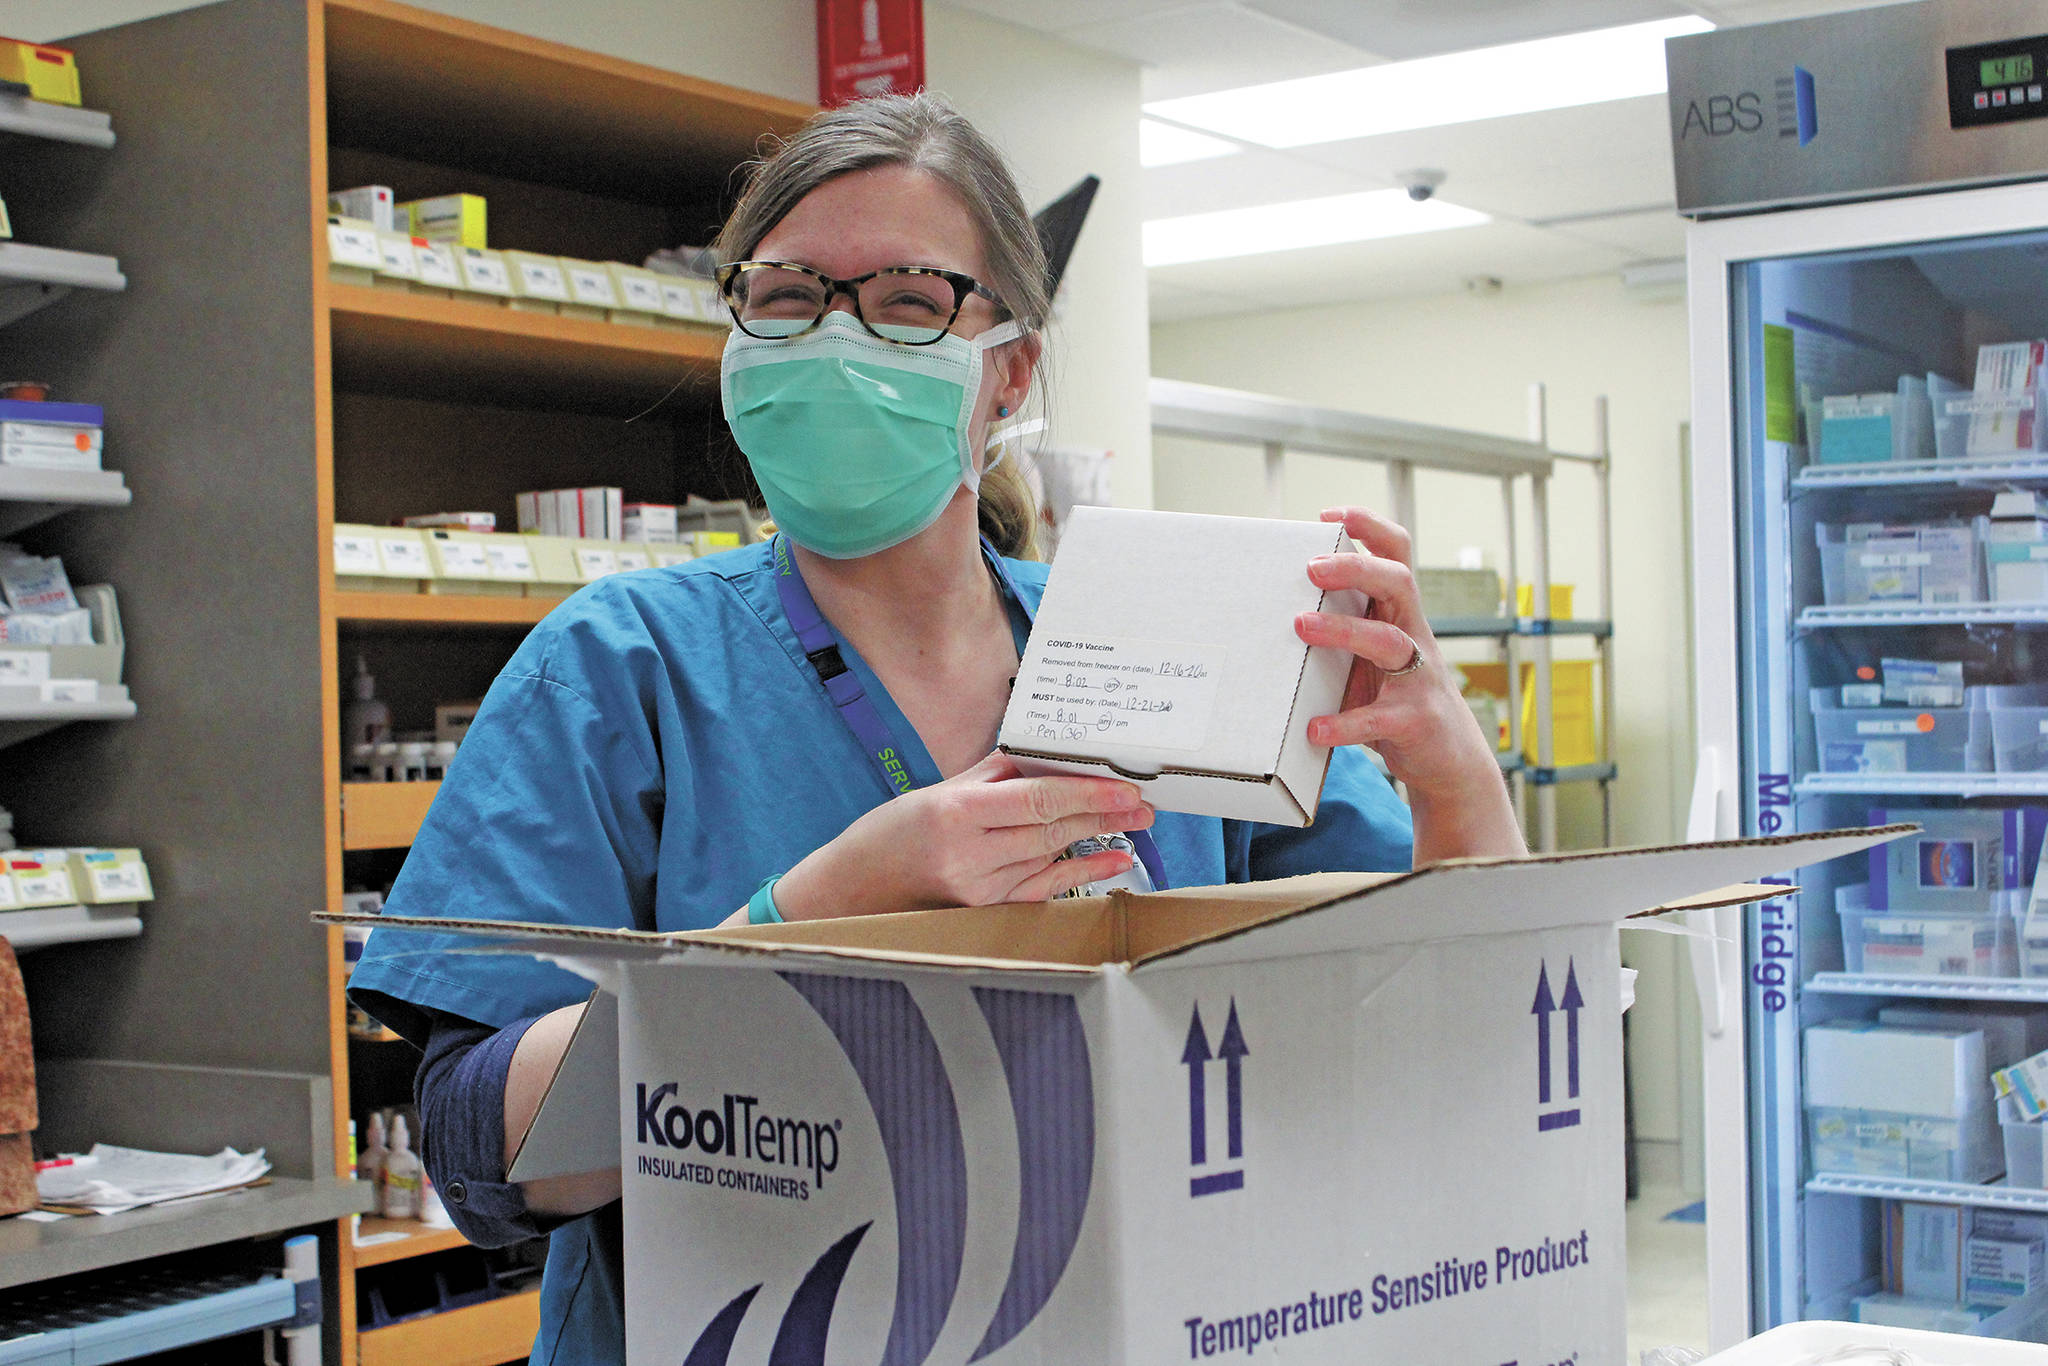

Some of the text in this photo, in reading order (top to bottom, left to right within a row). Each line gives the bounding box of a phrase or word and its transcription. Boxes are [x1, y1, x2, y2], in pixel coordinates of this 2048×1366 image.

[1681, 91, 1763, 140] ABS
[1047, 640, 1114, 652] COVID-19 Vaccine
[1041, 657, 1076, 667] Removed
[1077, 660, 1094, 669] from
[1095, 662, 1121, 671] freezer
[1132, 664, 1154, 674] (date)
[1036, 676, 1058, 685] (time)
[1065, 673, 1088, 688] 8:02
[1031, 693, 1055, 702] MUST
[1066, 697, 1084, 705] used
[1098, 699, 1121, 709] (Date)
[1026, 710, 1050, 720] (Time)
[638, 1155, 809, 1201] INSULATED CONTAINERS
[1184, 1229, 1589, 1360] Temperature Sensitive Product
